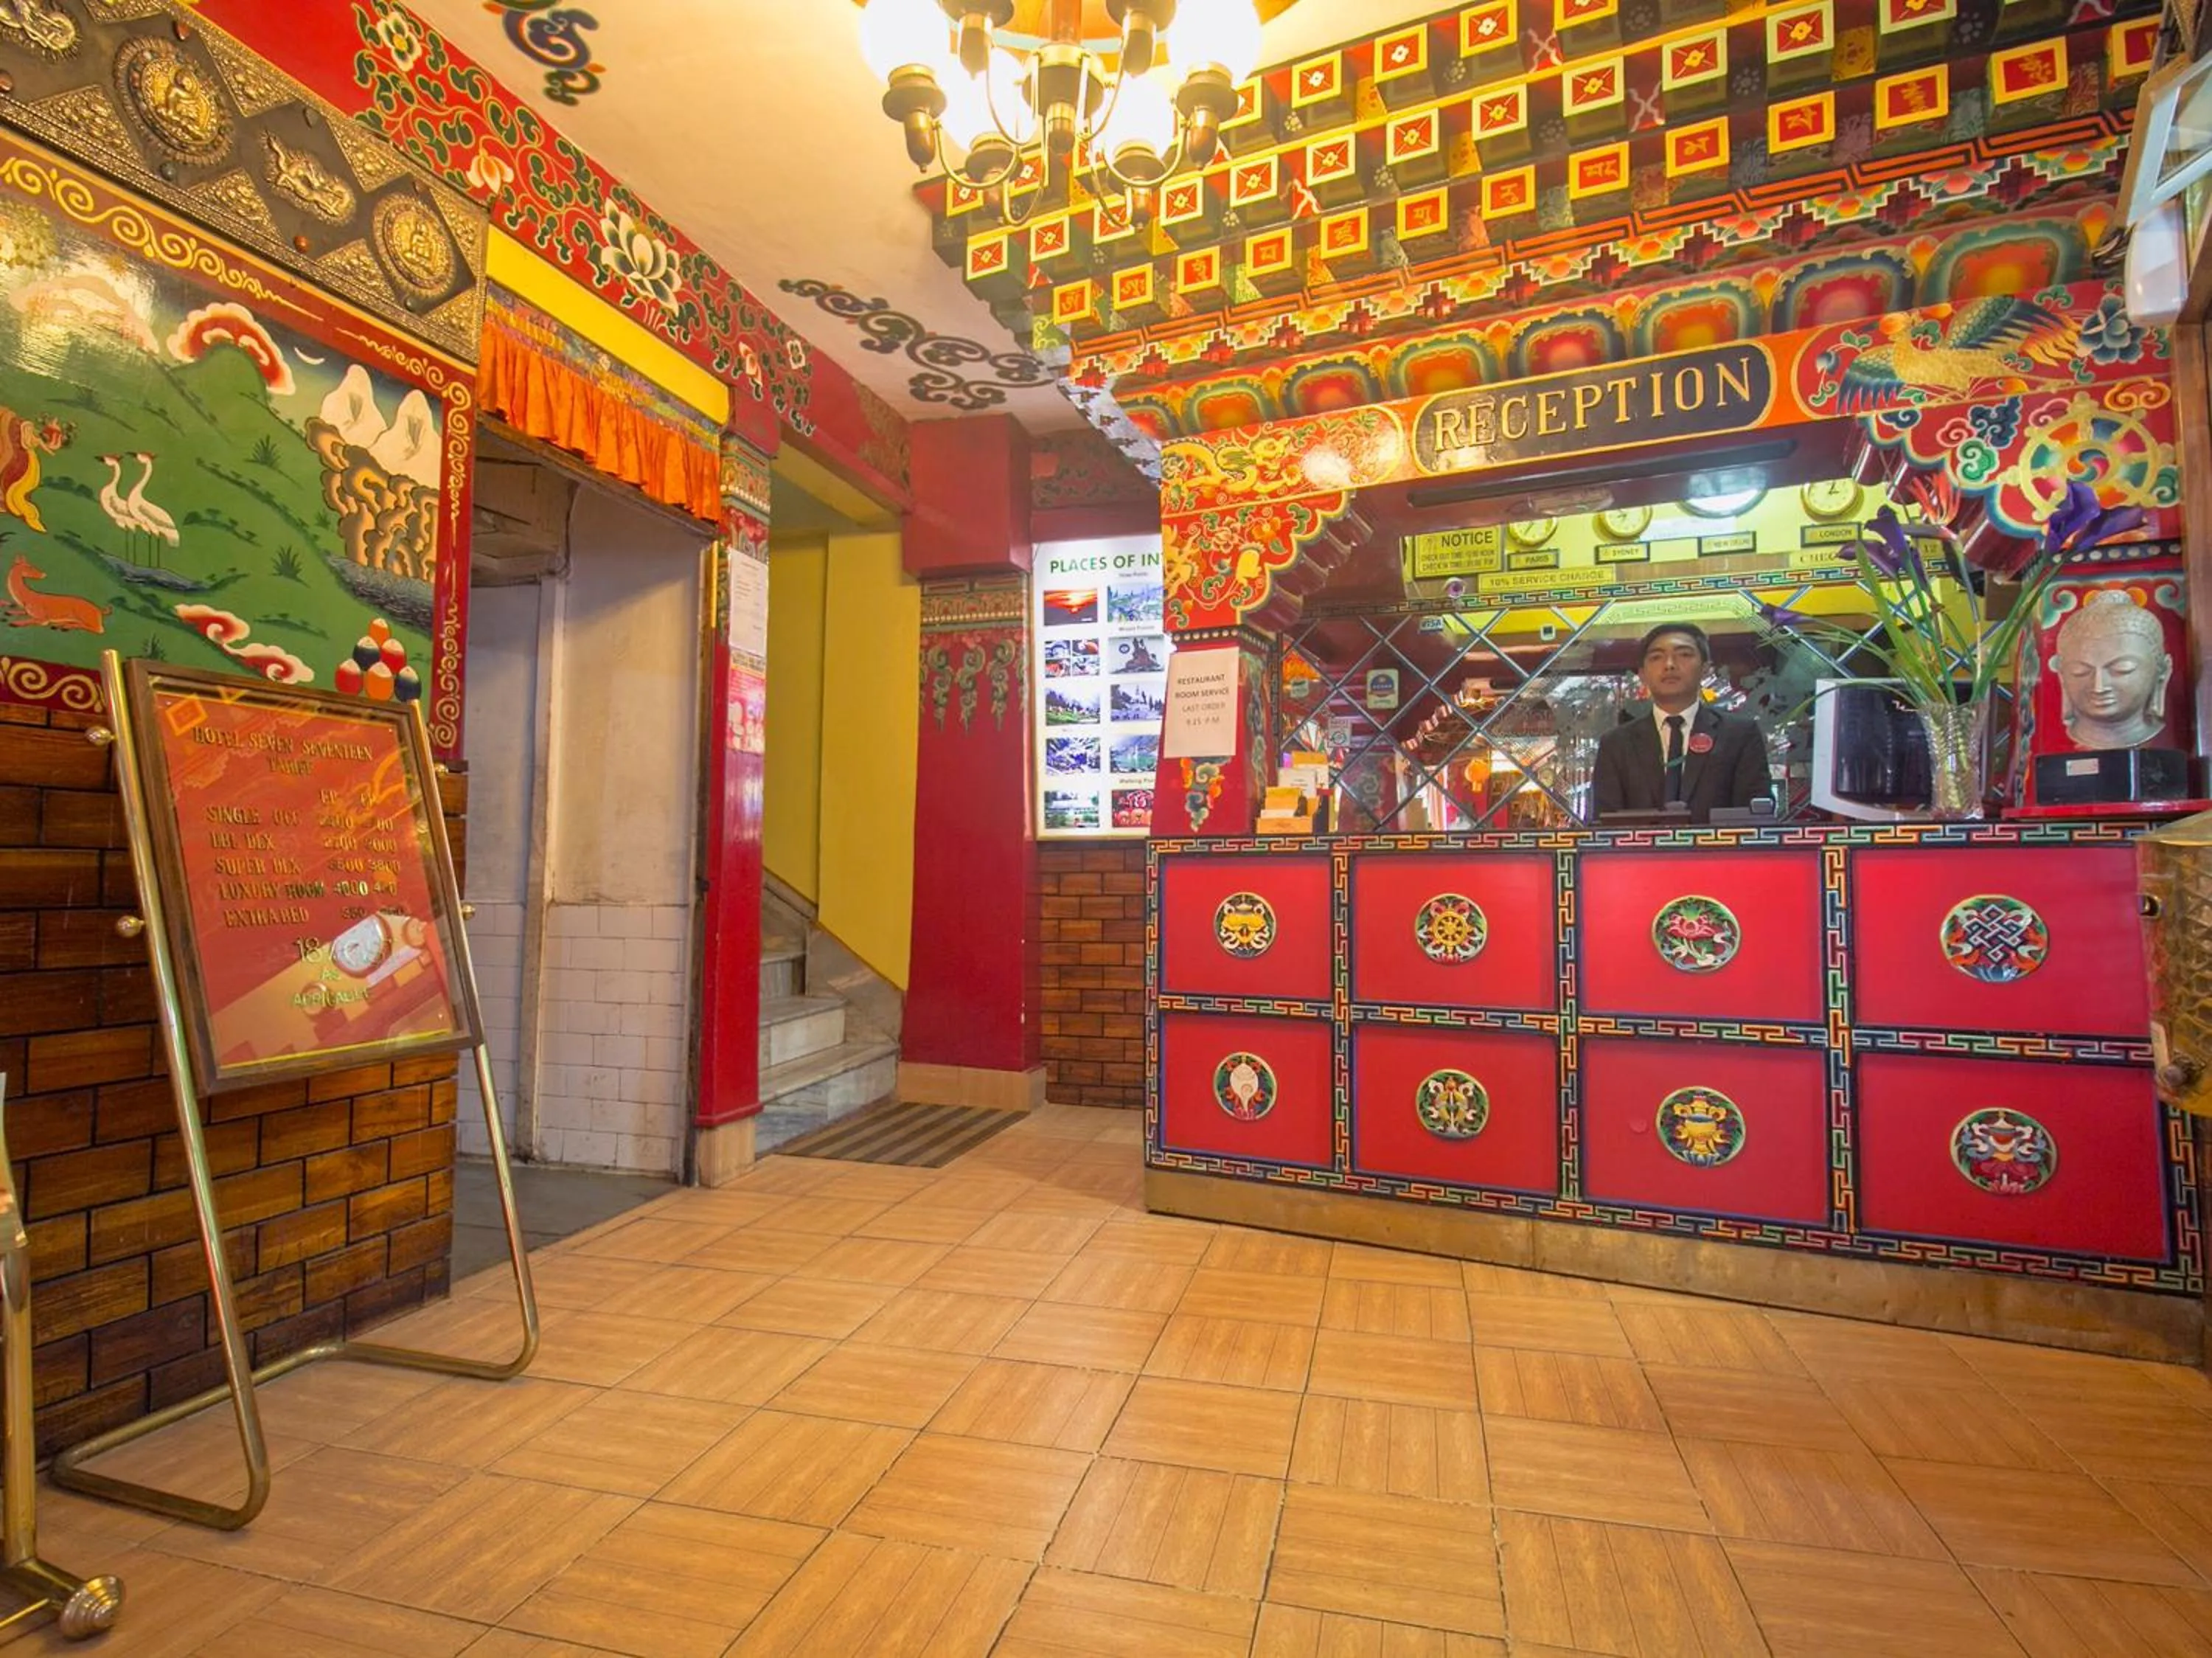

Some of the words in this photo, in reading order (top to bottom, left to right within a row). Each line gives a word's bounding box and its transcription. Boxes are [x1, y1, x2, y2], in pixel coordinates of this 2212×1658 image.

[1433, 357, 1751, 453] RECEPTION
[1441, 530, 1493, 547] NOTICE
[1818, 529, 1853, 538] LONDON
[1525, 555, 1549, 564] PARIS
[1612, 547, 1639, 557] SYDNEY
[1800, 554, 1836, 563] CHEC
[1050, 557, 1107, 573] PLACES
[1113, 555, 1135, 569] OF
[1141, 552, 1161, 566] IN
[1489, 577, 1509, 586] 10%
[1512, 573, 1557, 585] SERVICE
[1559, 570, 1604, 581] CHARGE
[1422, 619, 1441, 628] VISA
[1178, 673, 1225, 684] RESTAURANT
[1175, 690, 1199, 698] ROOM
[1201, 687, 1229, 696] SERVICE
[1182, 704, 1200, 712] LAST
[193, 726, 244, 749] HOTEL
[248, 732, 293, 754] SEVEN
[302, 740, 373, 761] SEVENTEEN
[206, 807, 260, 825] SINGLE
[215, 858, 265, 875] SUPER
[219, 881, 280, 900] LUXURY
[285, 881, 324, 898] ROOM
[224, 908, 280, 928] EXTRA
[280, 908, 309, 923] BED
